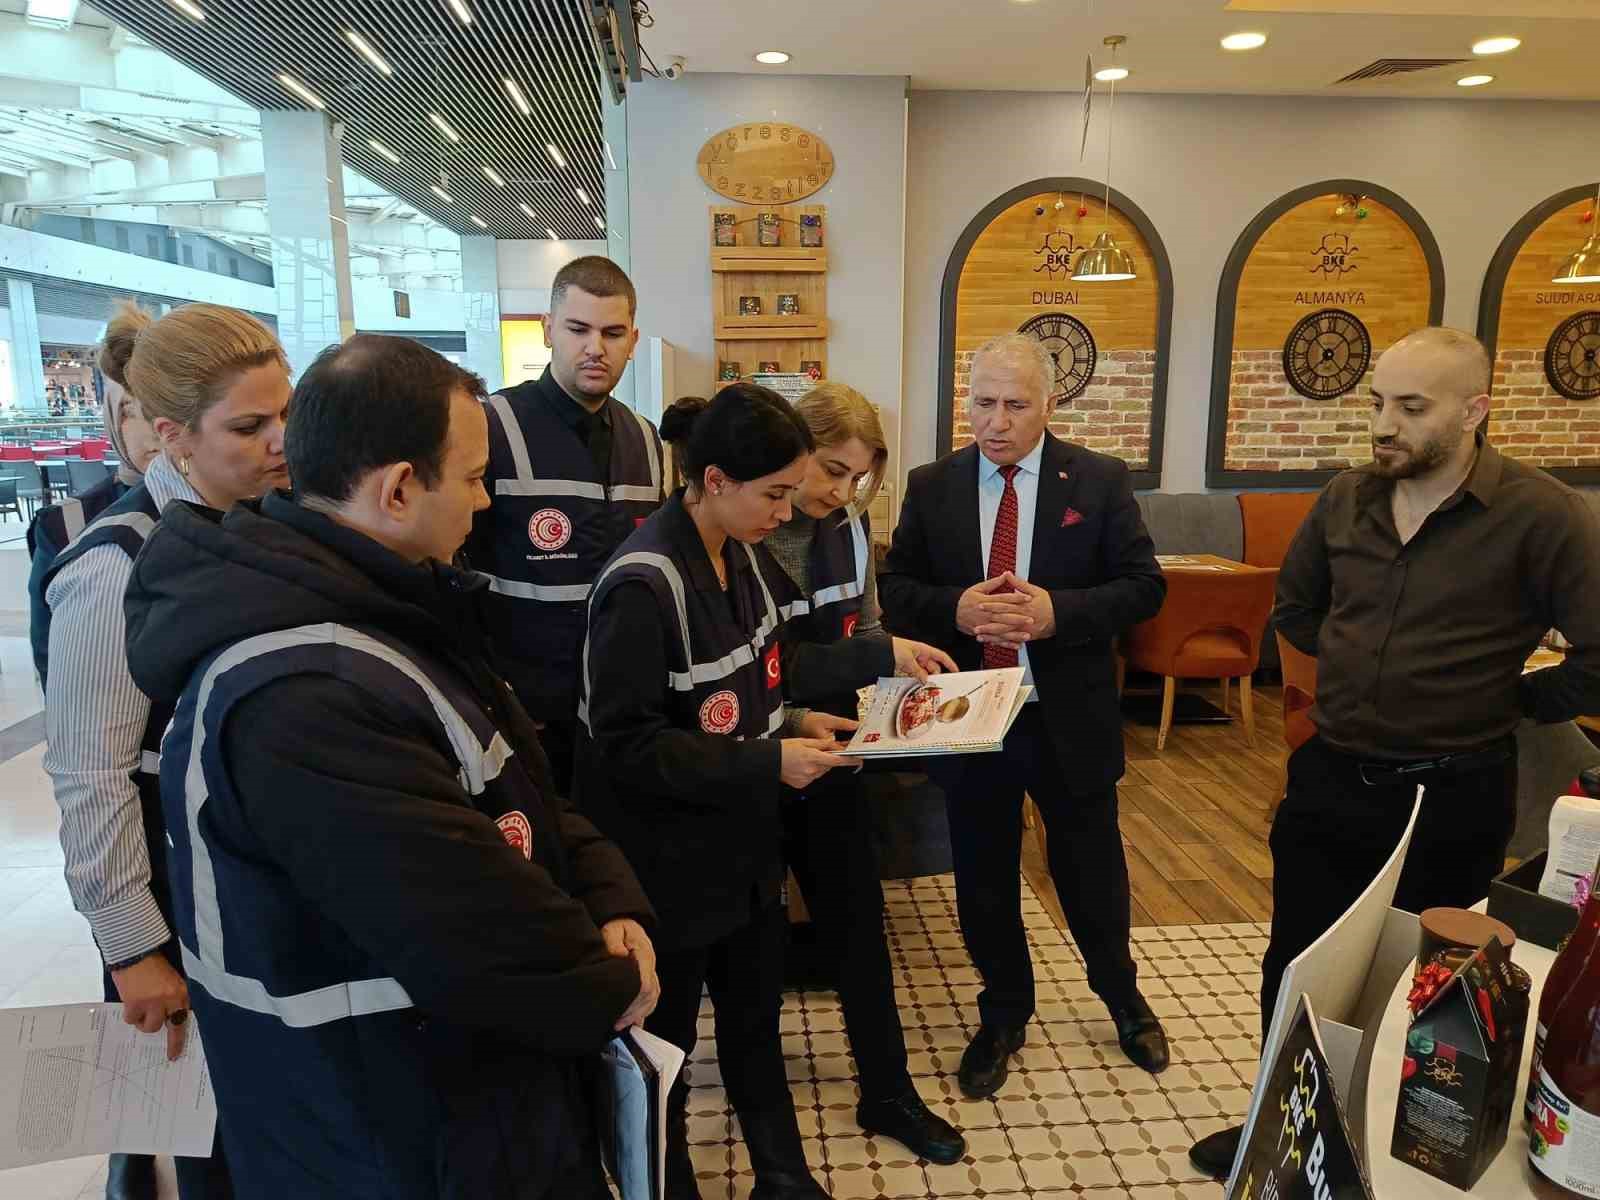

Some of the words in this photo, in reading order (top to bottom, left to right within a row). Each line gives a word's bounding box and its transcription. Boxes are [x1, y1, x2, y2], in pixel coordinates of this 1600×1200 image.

[1046, 254, 1071, 265] BKE
[1322, 255, 1346, 265] BKE
[1032, 291, 1080, 305] DUBAI
[1294, 291, 1367, 305] ALMANYA
